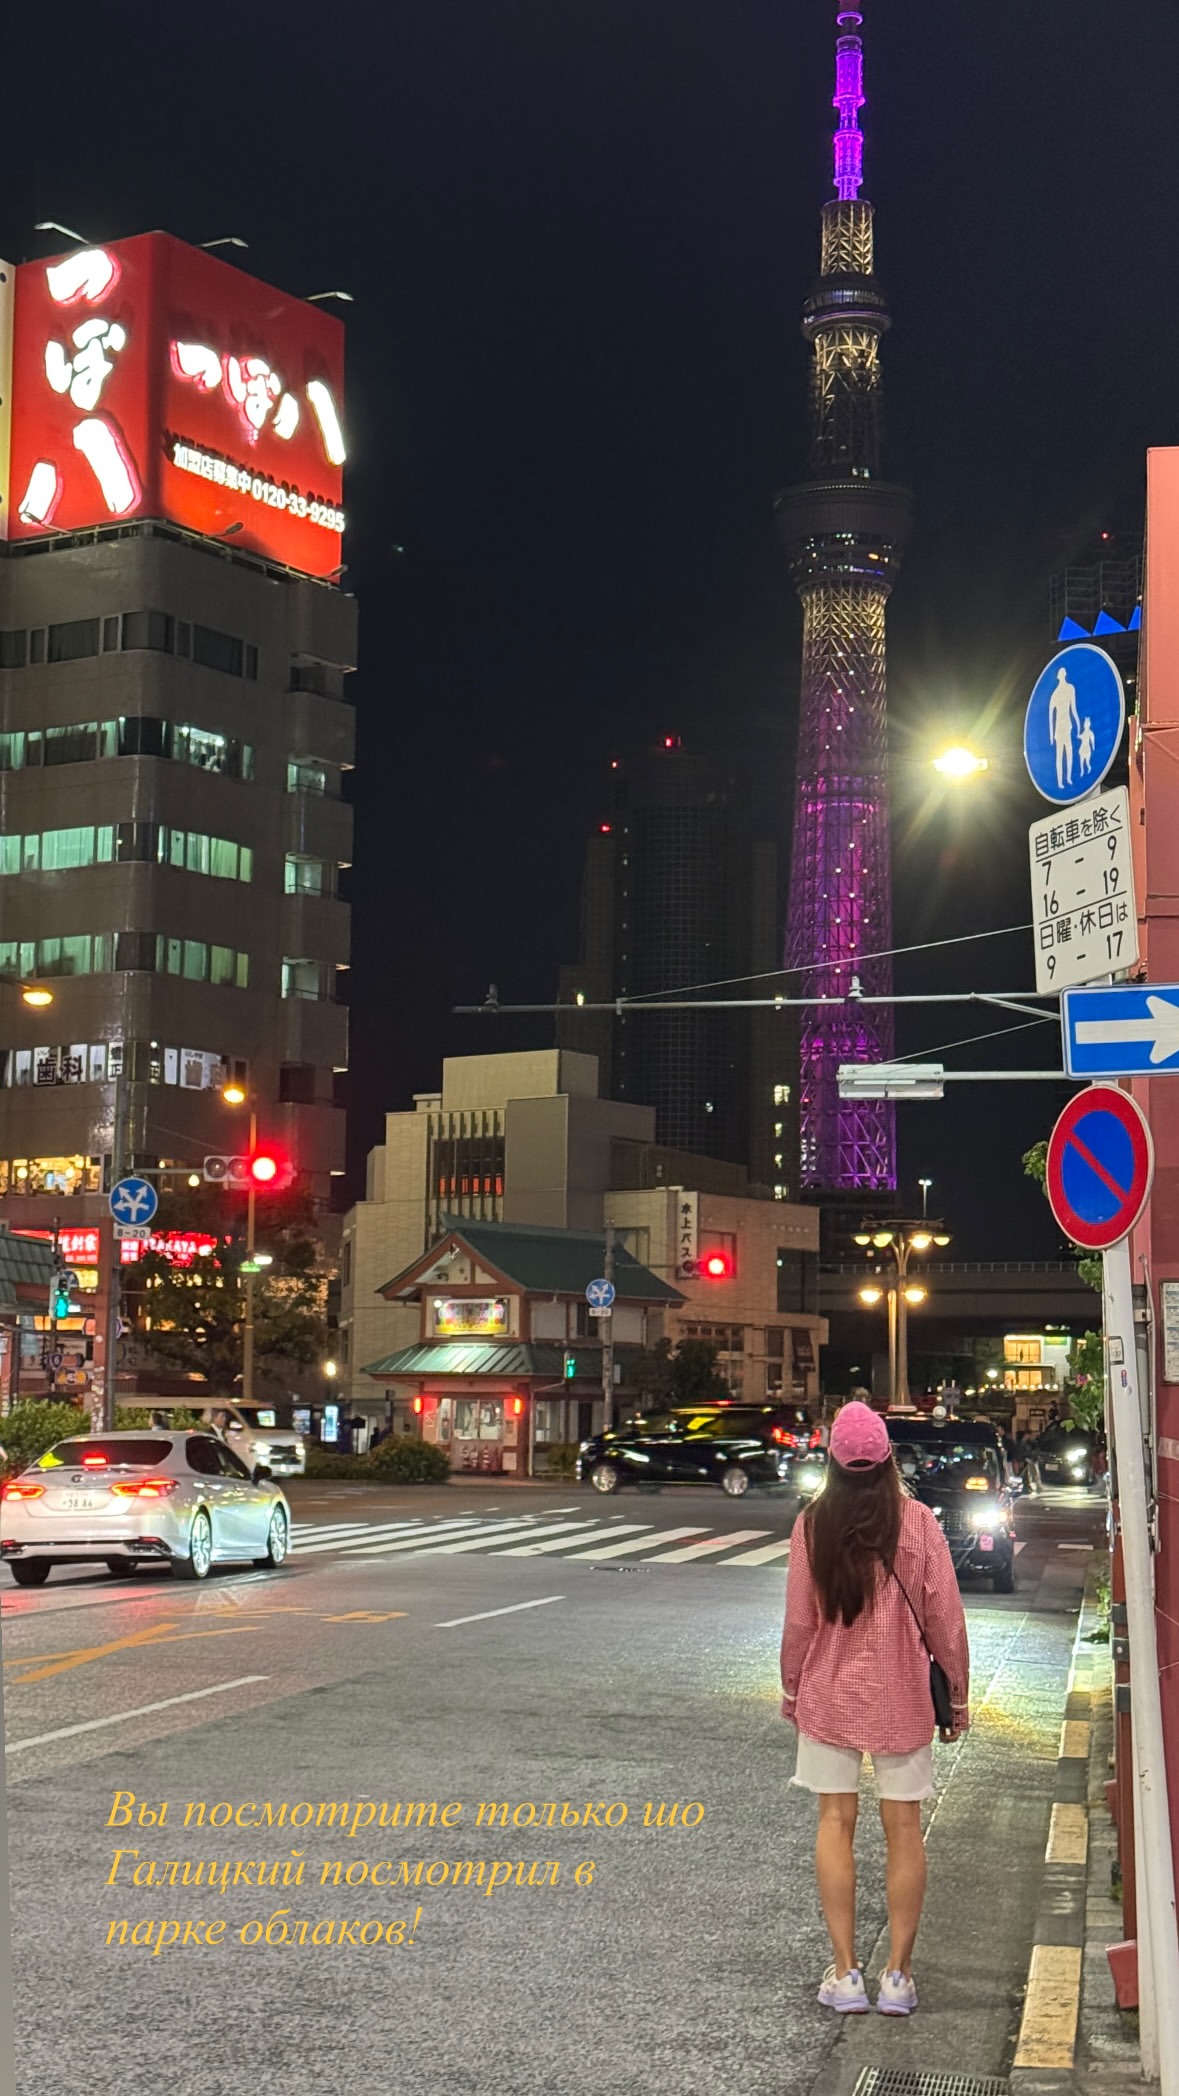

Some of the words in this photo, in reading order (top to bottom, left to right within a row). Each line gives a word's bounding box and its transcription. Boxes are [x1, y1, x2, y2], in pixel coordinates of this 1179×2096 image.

[172, 442, 252, 495] 加盟店募集中
[251, 478, 346, 533] 0120-33-9295
[1034, 803, 1122, 858] 自転車を除く
[1041, 860, 1052, 886] 7
[1107, 834, 1118, 861] 9
[1043, 889, 1060, 918] 16
[1103, 866, 1120, 896] 19
[1040, 900, 1129, 951] 日曜・休日は
[1046, 954, 1057, 981] 9
[1106, 930, 1124, 960] 17
[36, 1054, 83, 1085] 歯科
[116, 1228, 147, 1238] 8-20
[680, 1202, 692, 1258] 水上バス
